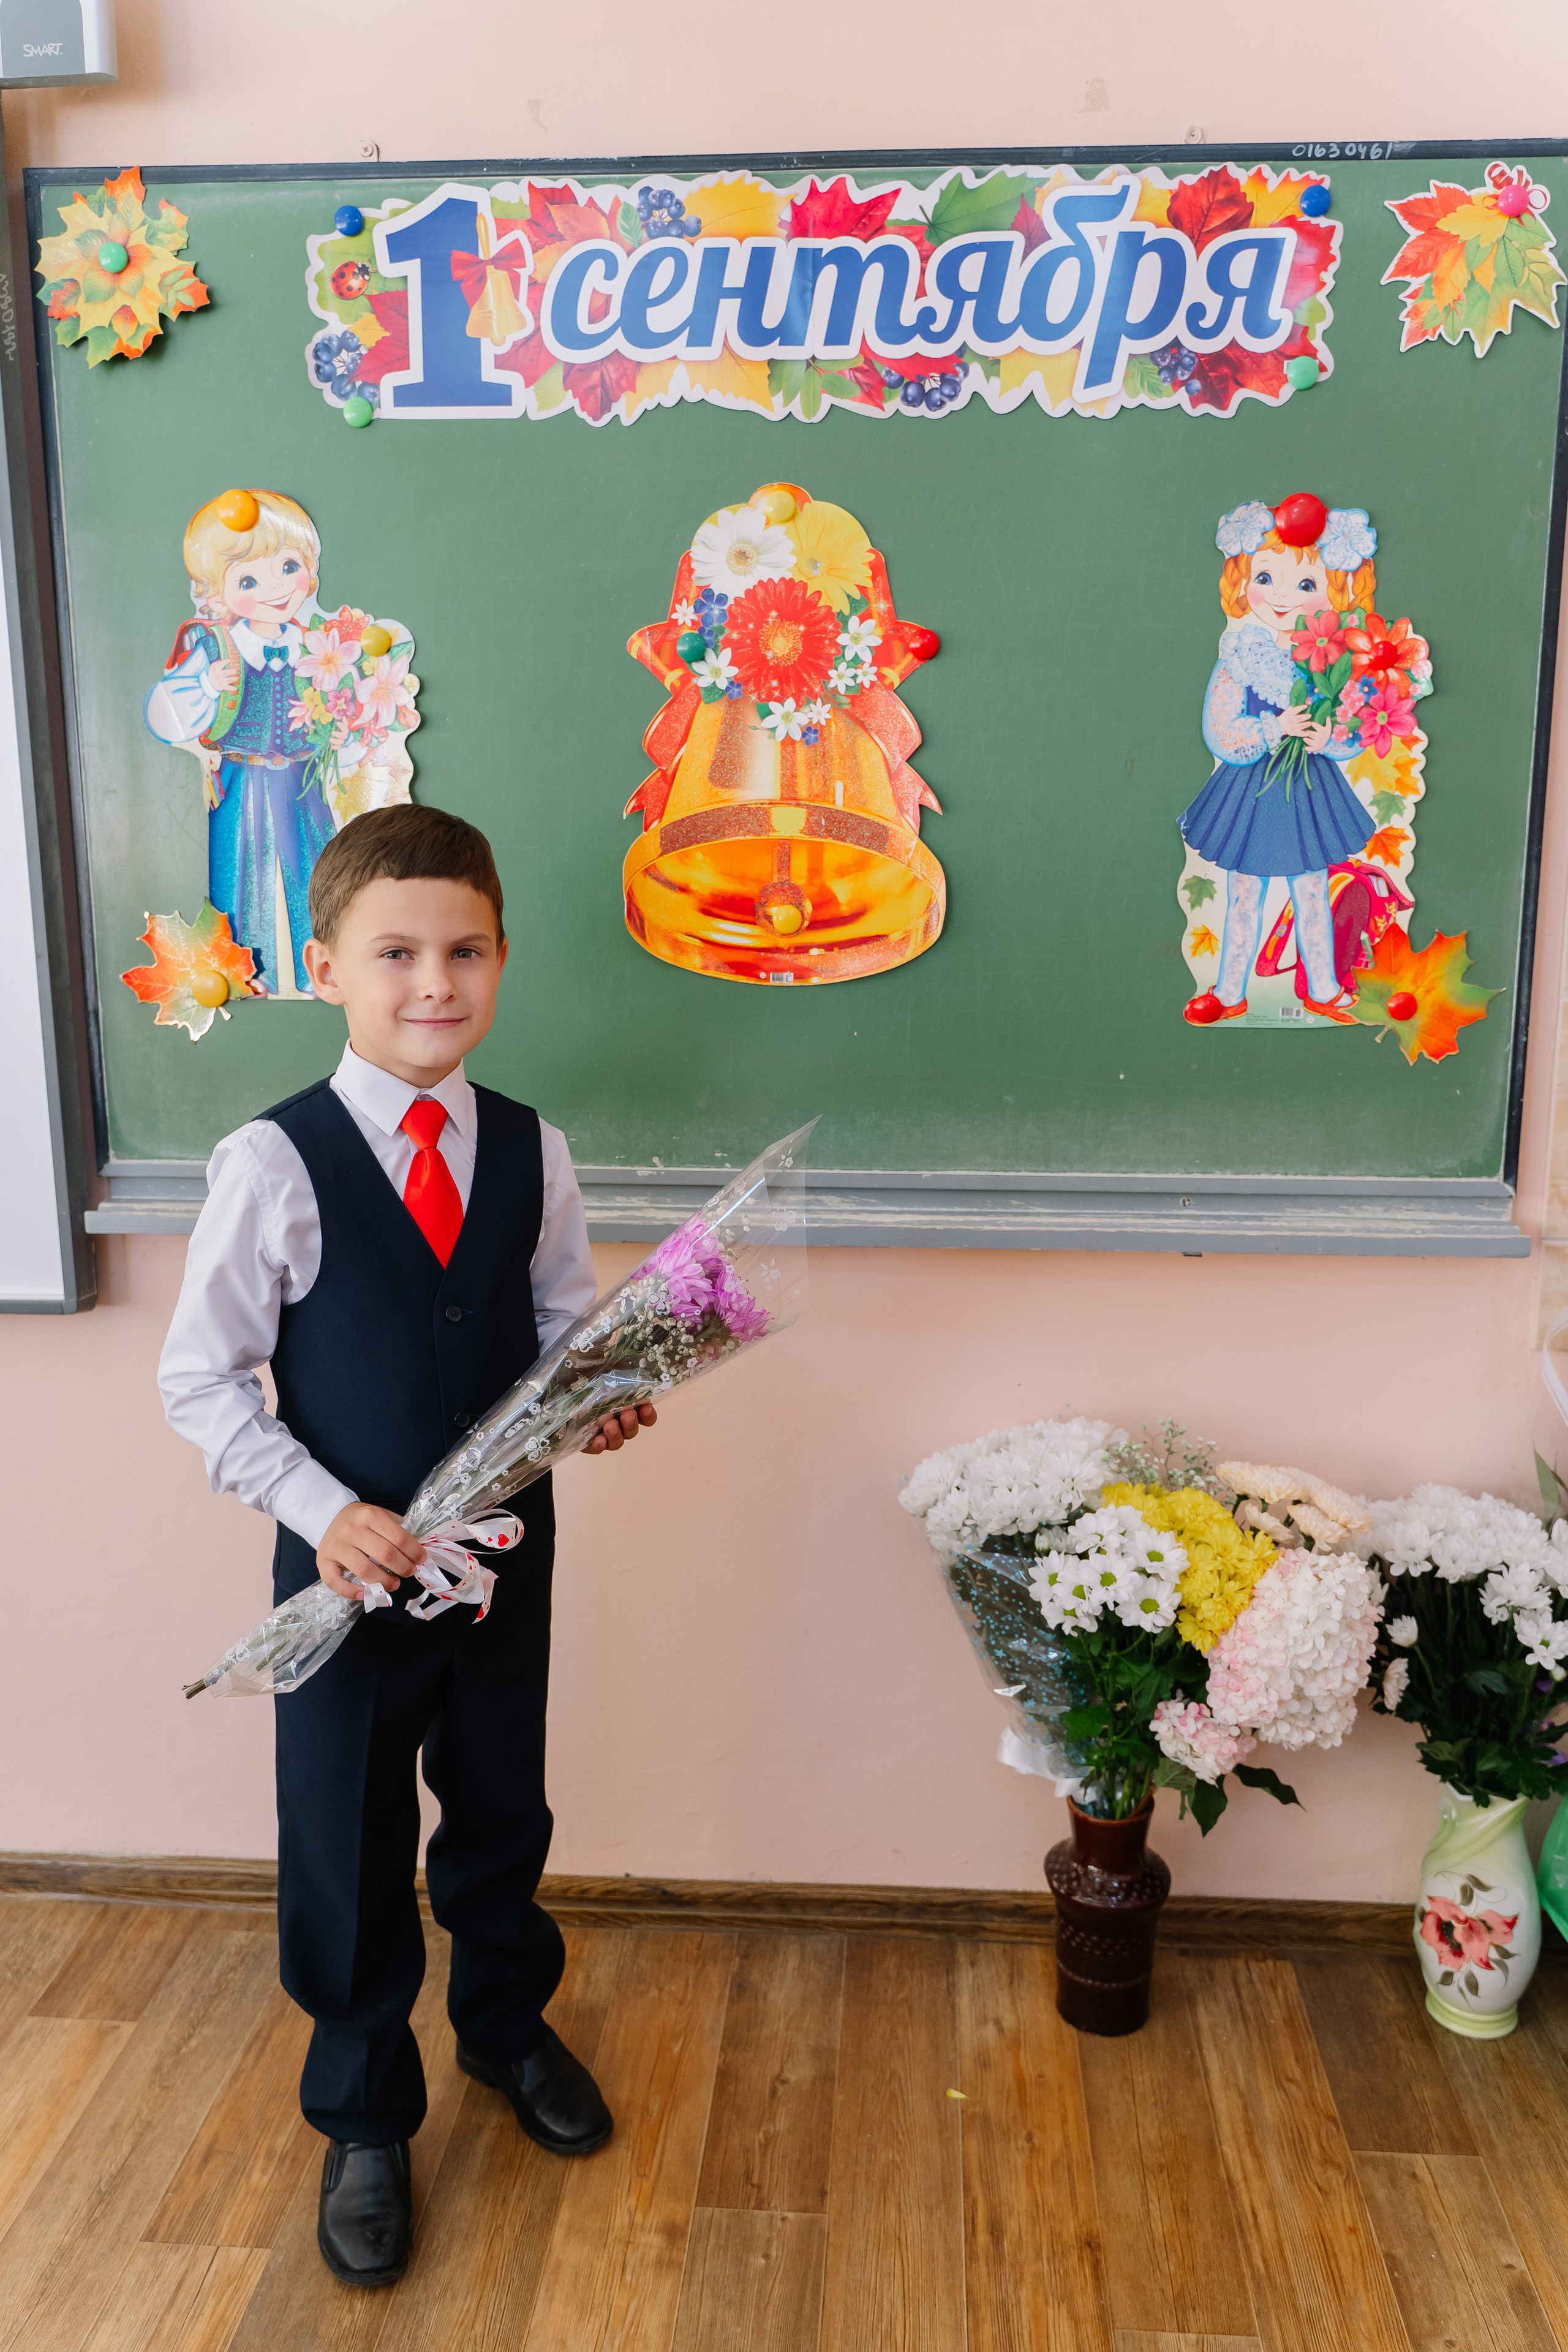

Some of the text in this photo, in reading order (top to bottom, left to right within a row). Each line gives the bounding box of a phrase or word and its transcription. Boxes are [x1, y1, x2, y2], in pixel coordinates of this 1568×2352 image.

[23, 43, 63, 57] SMART
[385, 184, 1287, 408] 1 сентября
